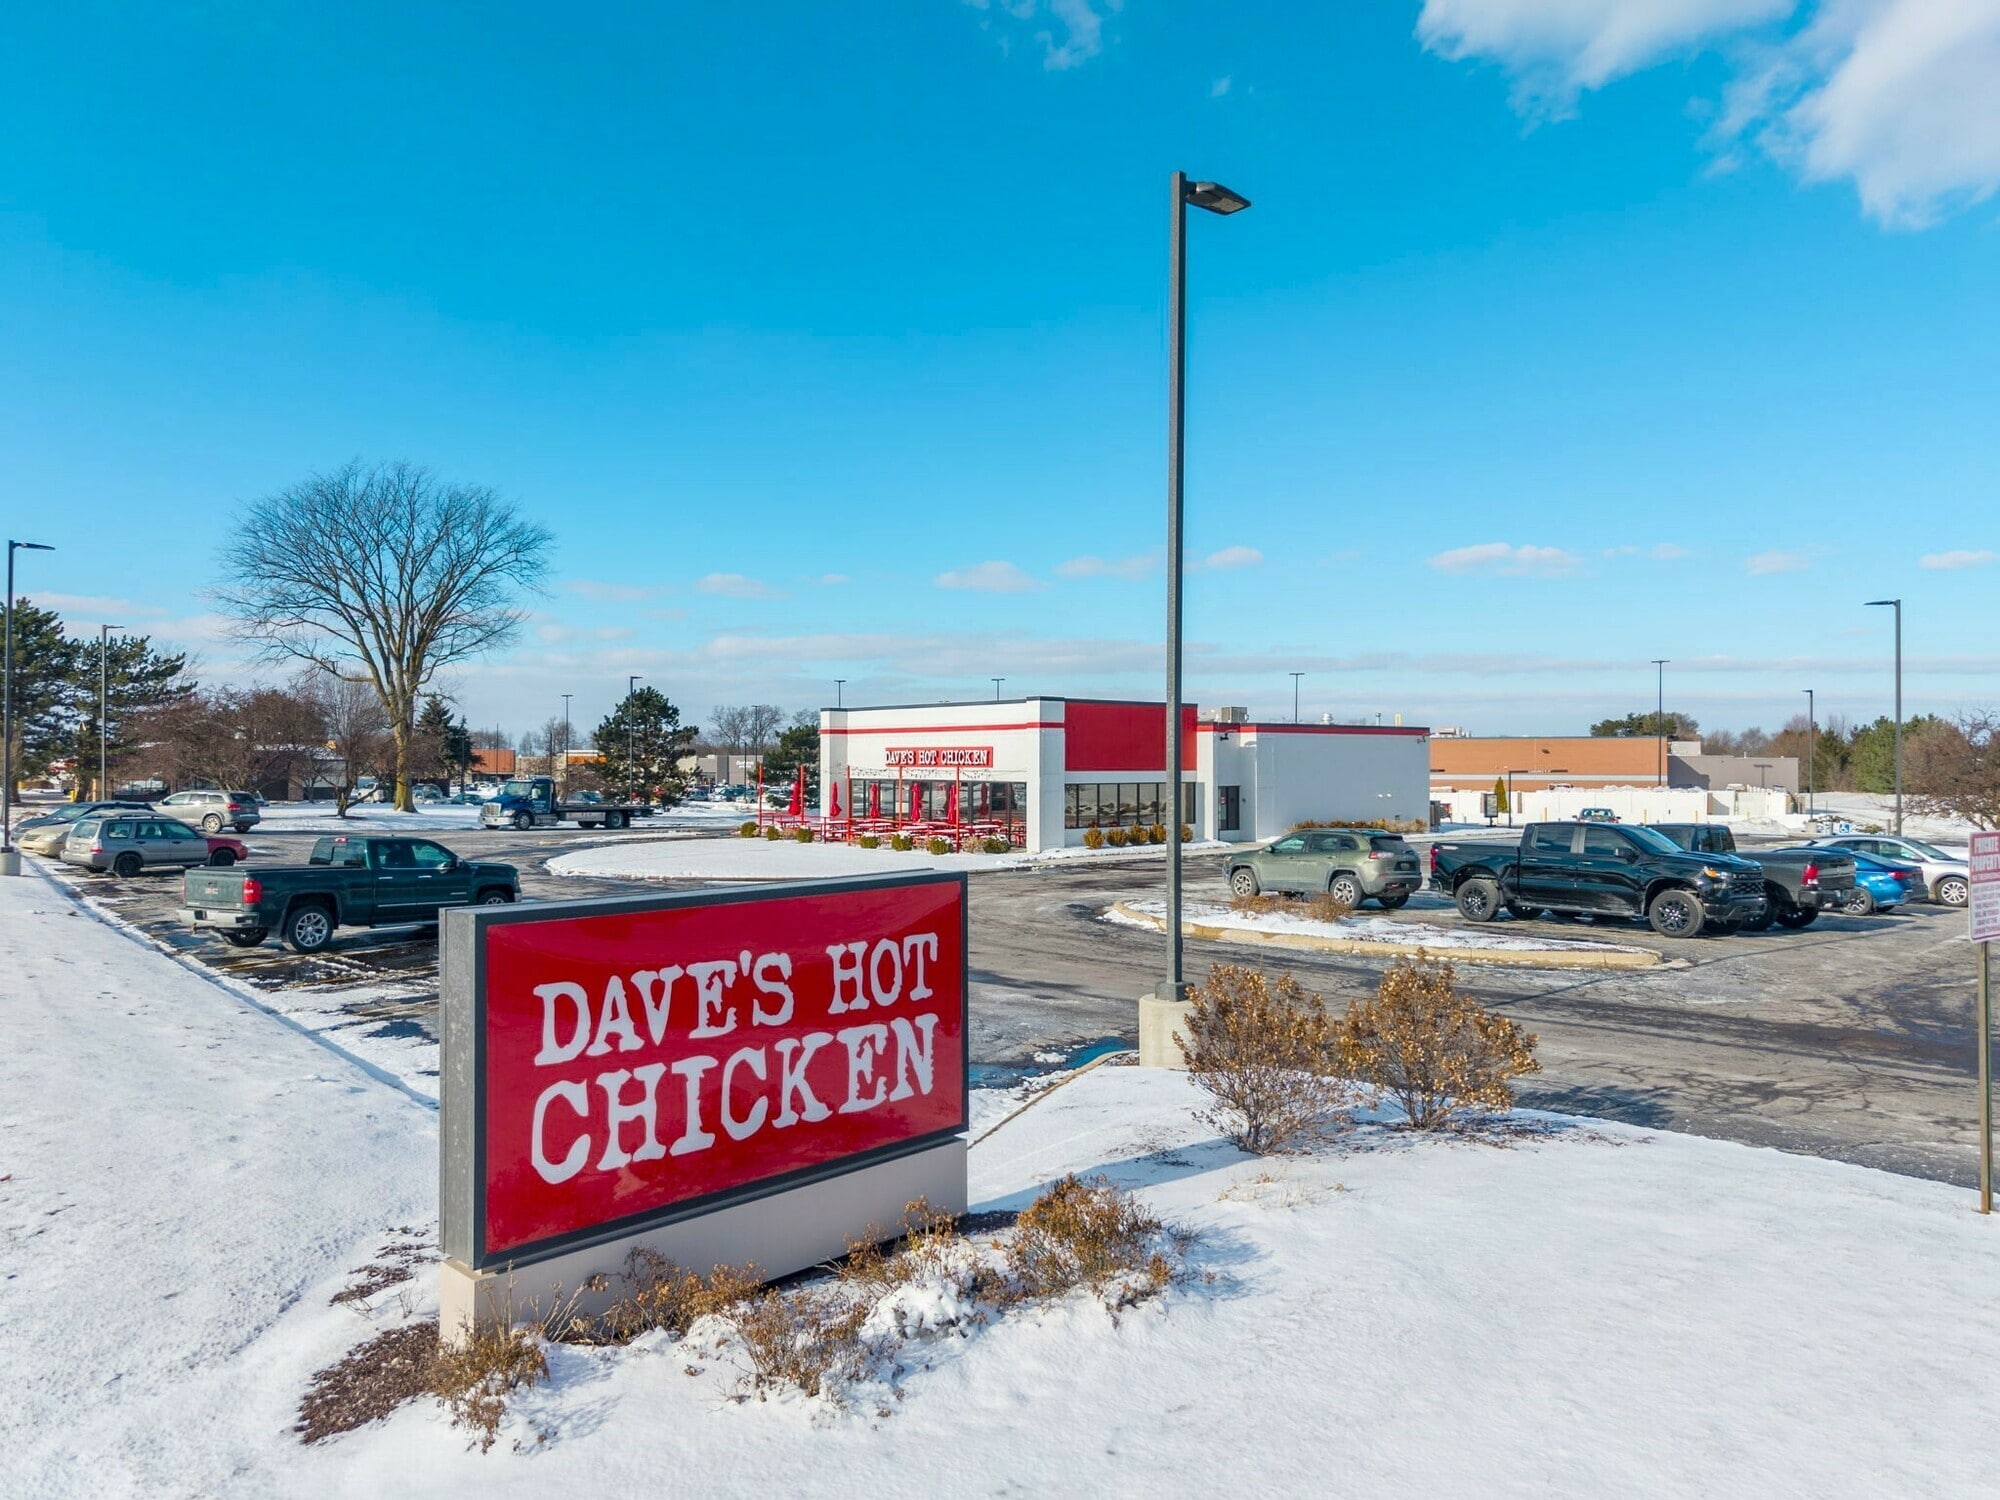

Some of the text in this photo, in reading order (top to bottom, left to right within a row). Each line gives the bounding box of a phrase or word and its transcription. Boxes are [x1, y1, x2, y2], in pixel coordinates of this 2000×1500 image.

[885, 749, 988, 765] DAVE'S HOT CHICKEN
[533, 932, 938, 1066] DAVE'S HOT
[531, 1013, 939, 1185] CHICKEN
